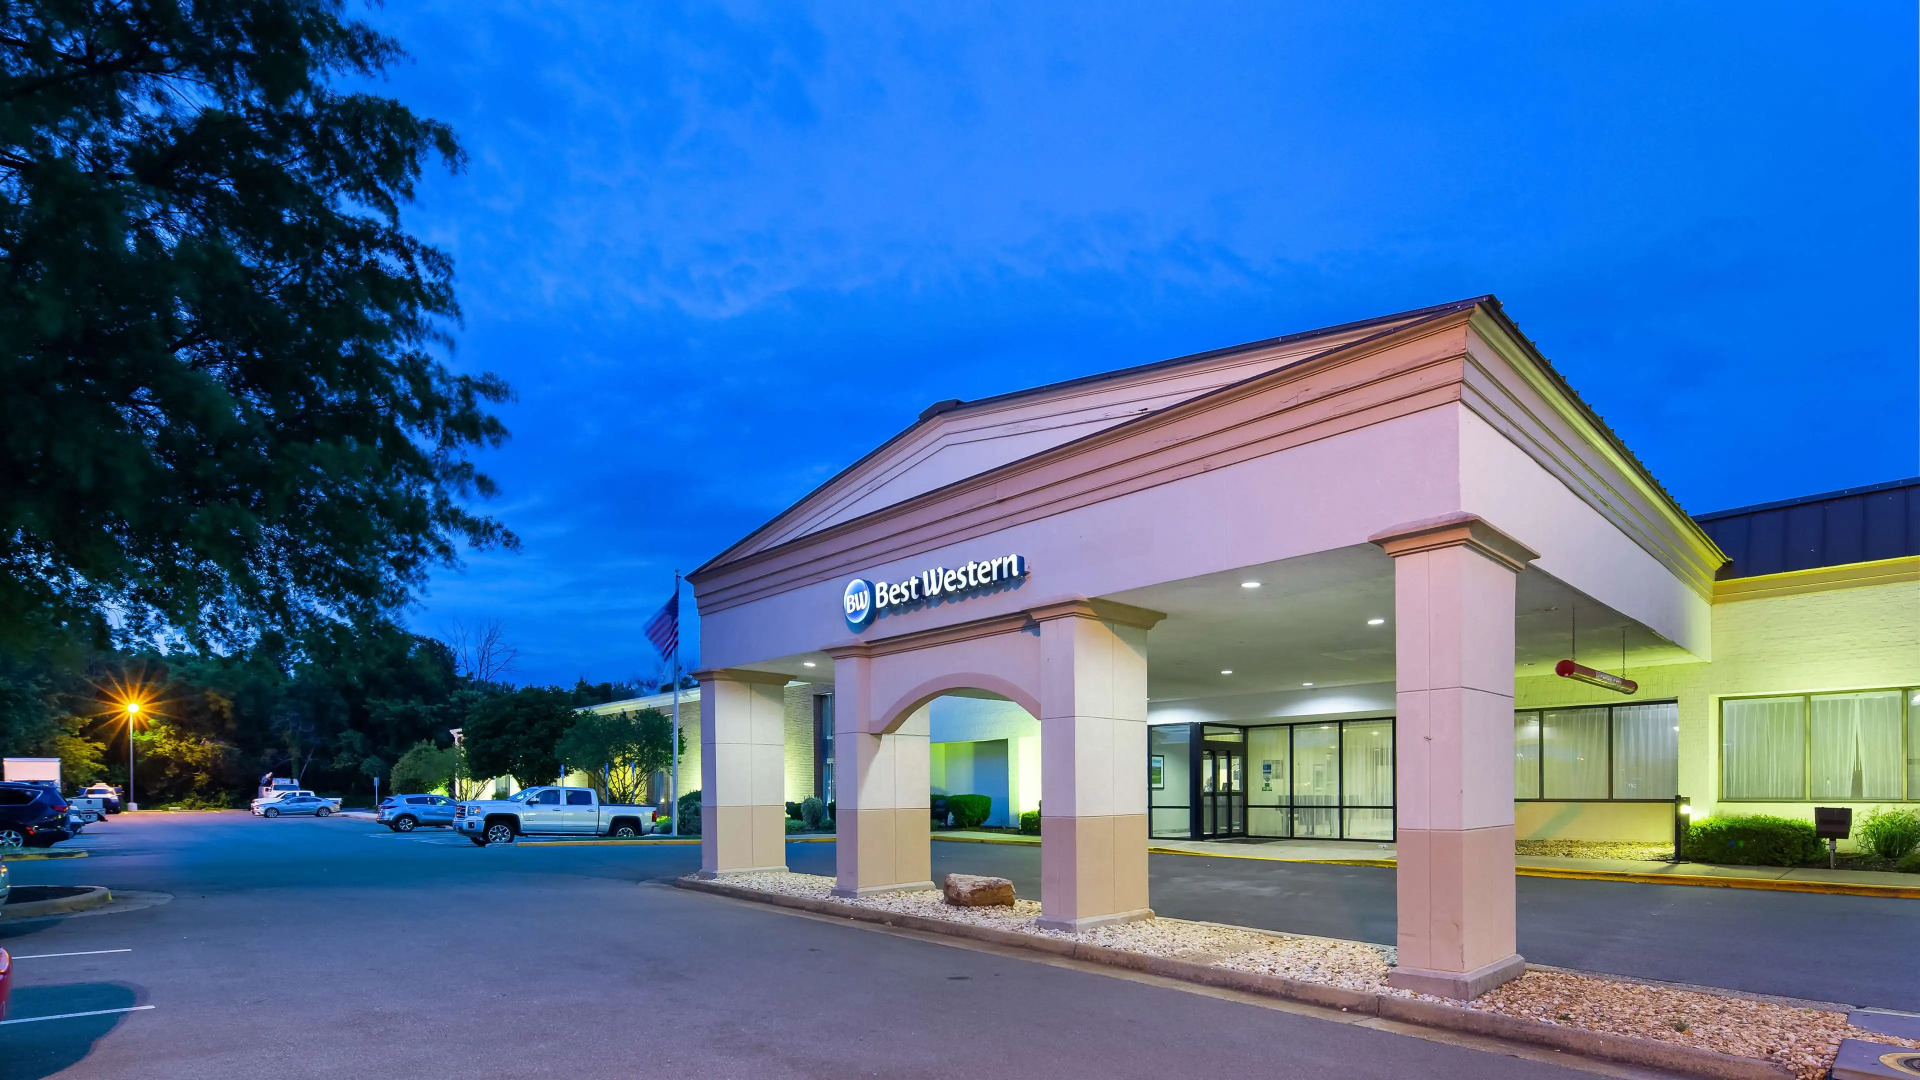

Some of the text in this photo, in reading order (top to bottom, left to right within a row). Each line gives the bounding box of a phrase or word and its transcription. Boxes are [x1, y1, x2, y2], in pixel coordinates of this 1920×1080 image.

[875, 553, 1019, 608] Best Western
[845, 590, 868, 614] BW
